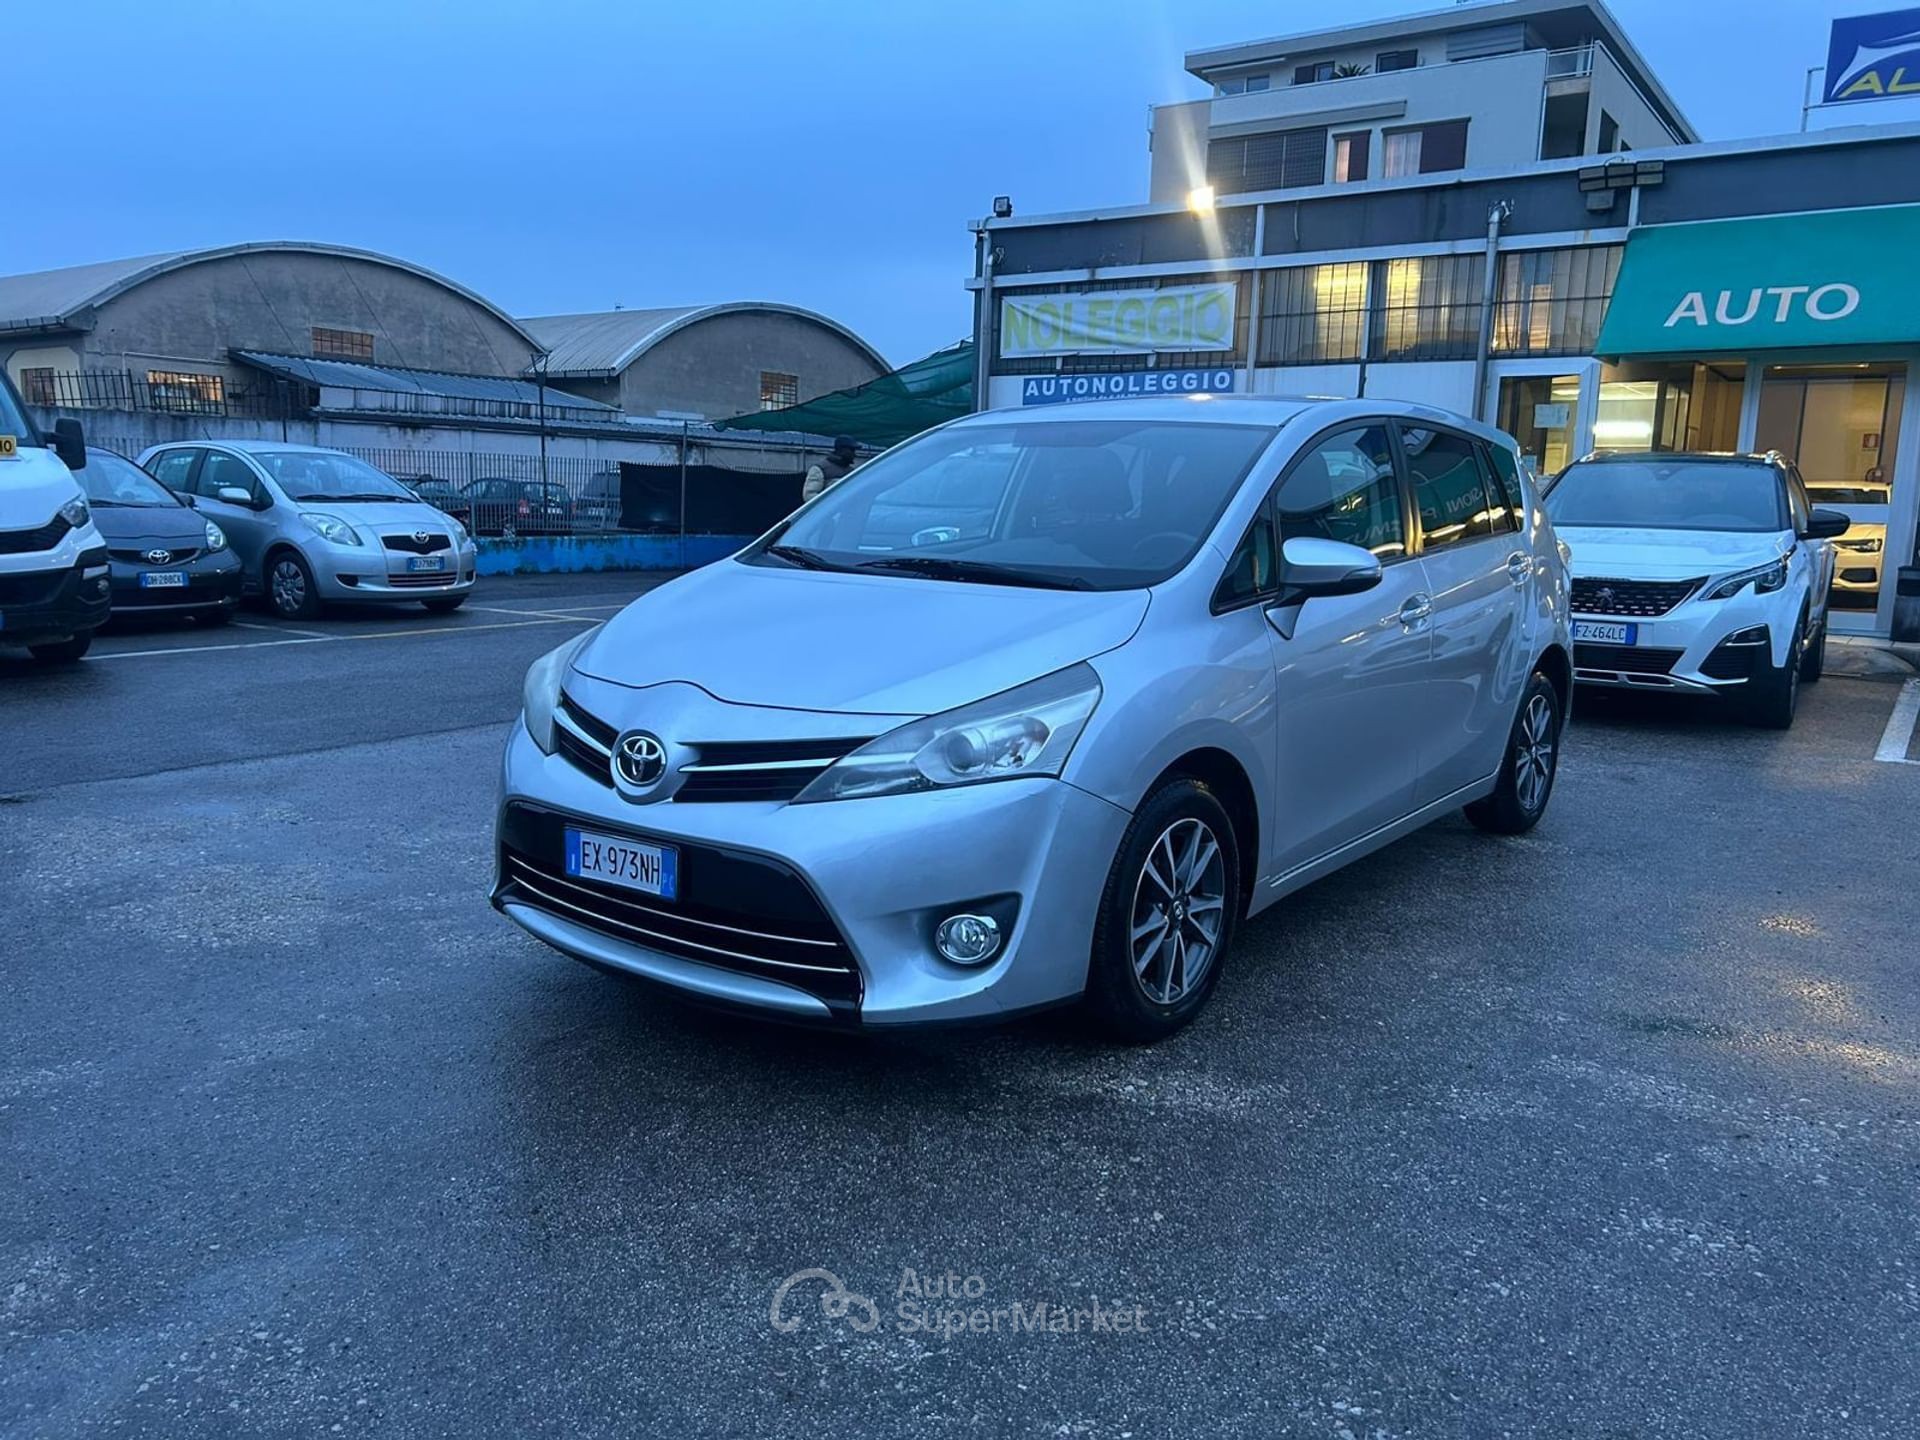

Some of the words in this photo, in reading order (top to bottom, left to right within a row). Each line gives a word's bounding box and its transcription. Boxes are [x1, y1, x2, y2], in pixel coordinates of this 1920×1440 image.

[1005, 291, 1229, 349] NOLEGGIO
[1664, 283, 1860, 327] AUTO
[1025, 371, 1231, 396] AUTONOLEGGIO
